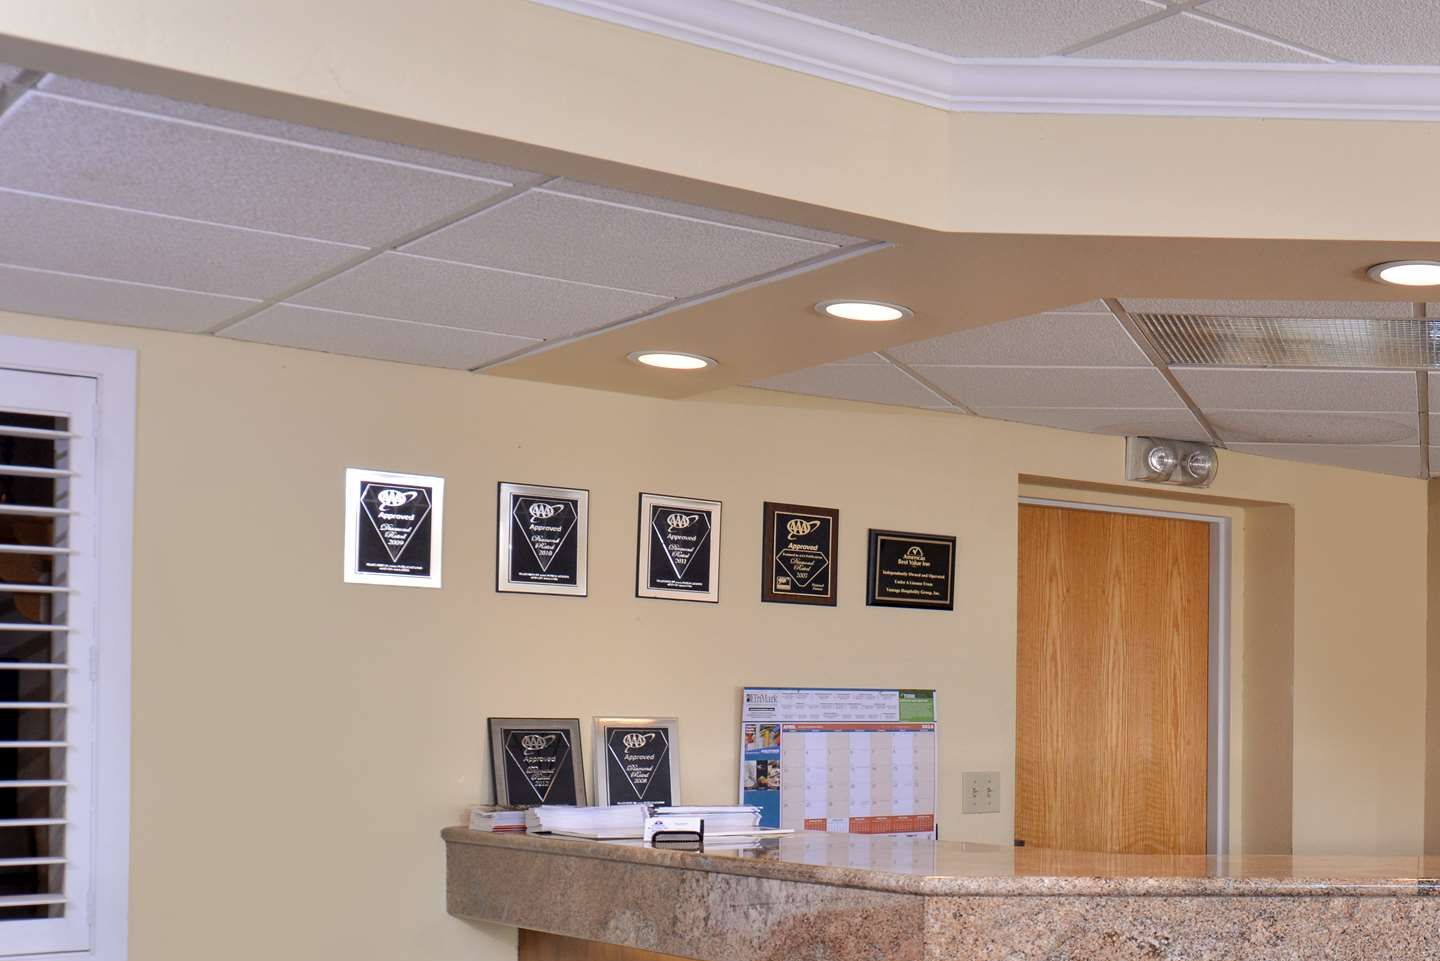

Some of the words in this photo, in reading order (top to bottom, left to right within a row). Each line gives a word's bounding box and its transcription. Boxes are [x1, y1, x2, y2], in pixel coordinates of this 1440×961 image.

[378, 512, 415, 520] Approved
[529, 524, 562, 532] Approved
[667, 533, 697, 542] Approved
[788, 542, 818, 551] Approved
